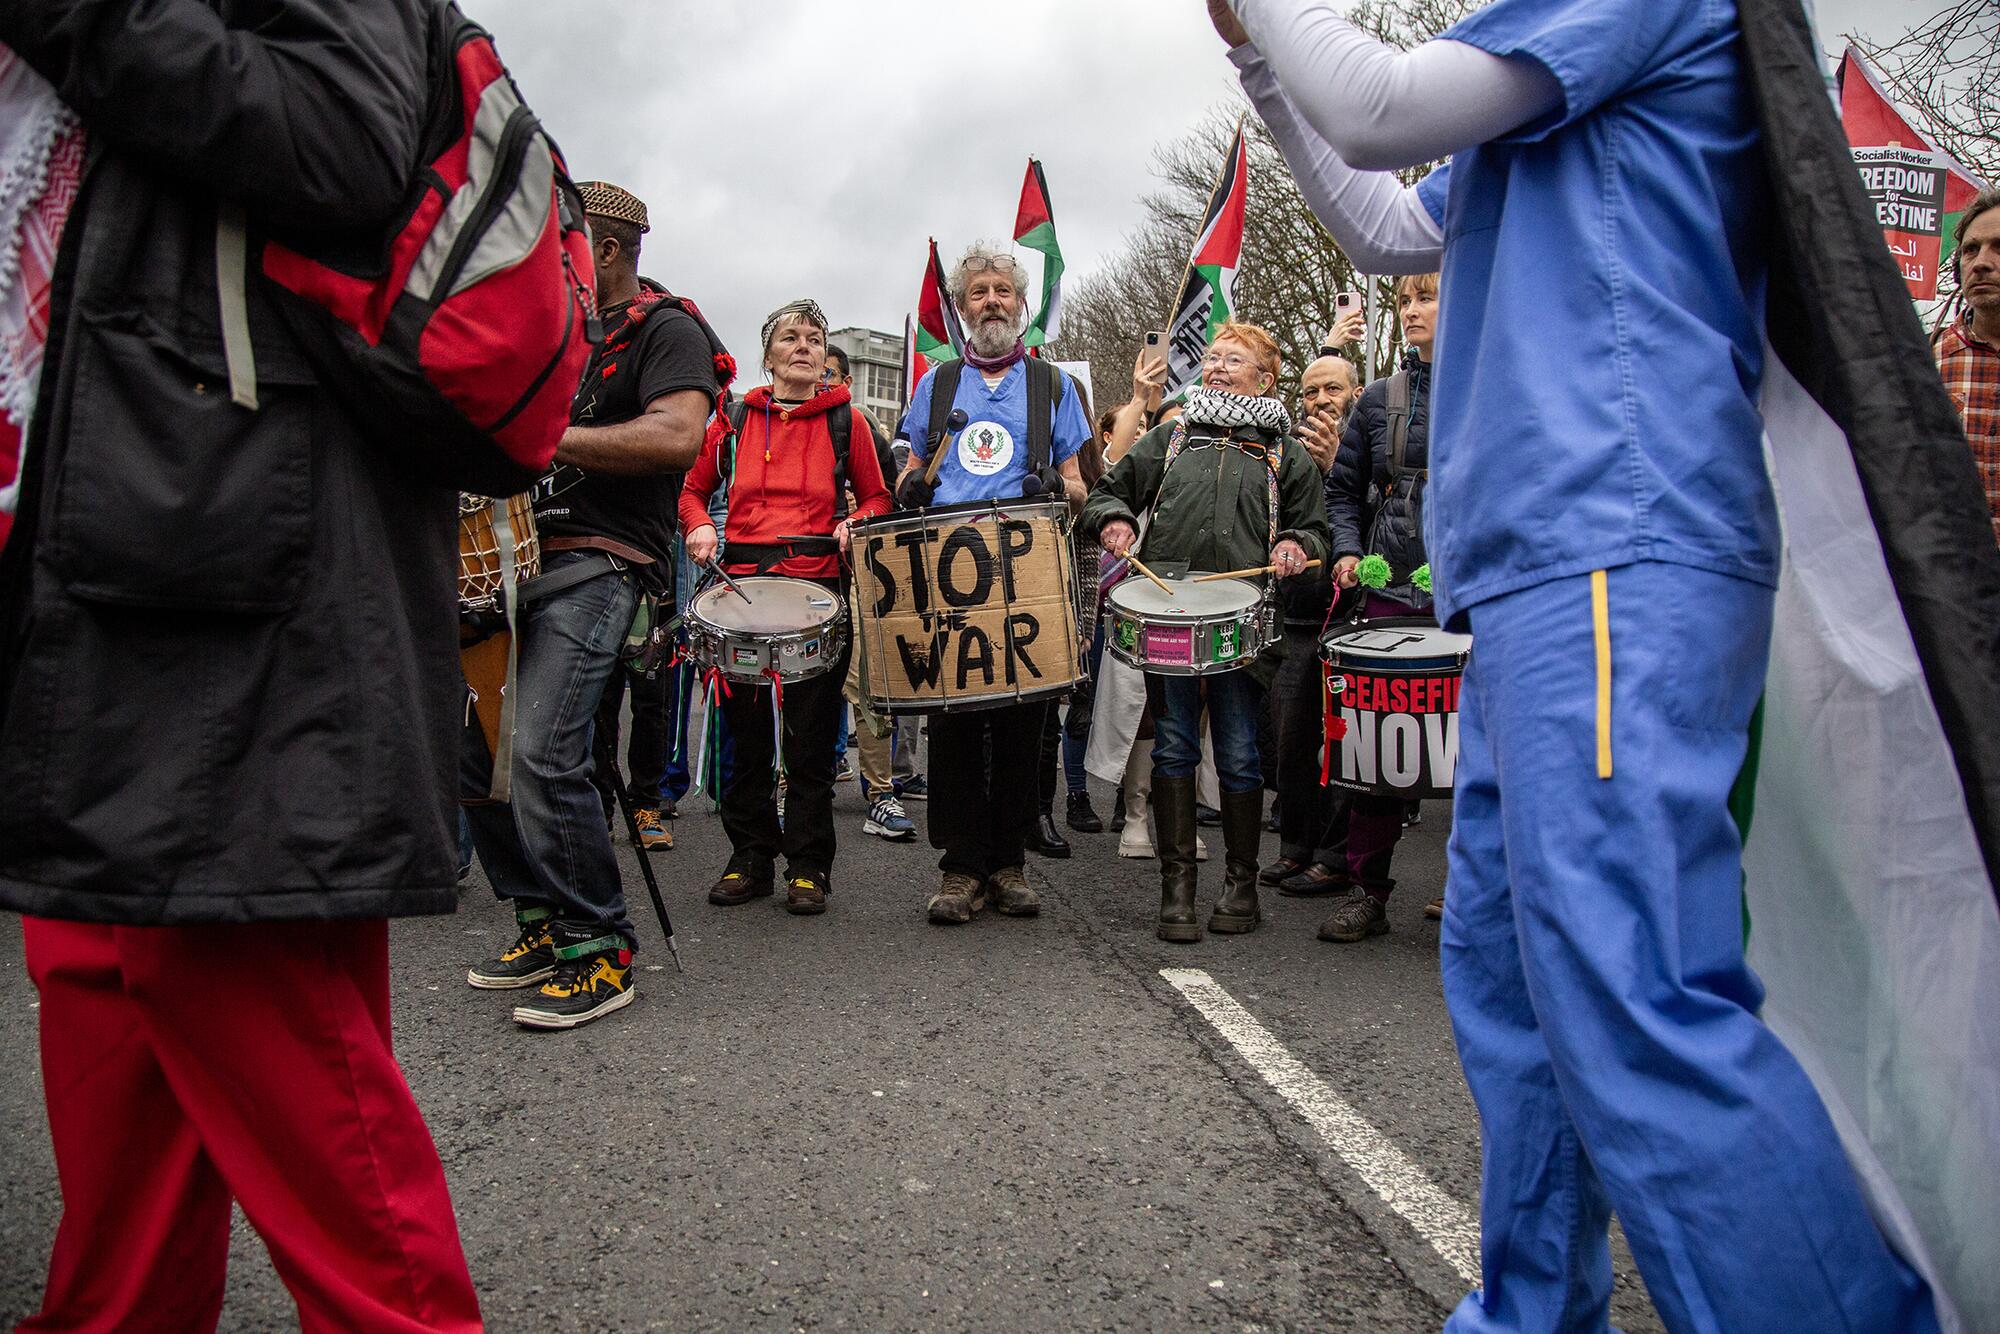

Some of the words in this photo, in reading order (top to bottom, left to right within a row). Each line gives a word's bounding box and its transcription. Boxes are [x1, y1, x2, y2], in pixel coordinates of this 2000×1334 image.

[1854, 150, 1900, 161] Socialist
[1900, 151, 1933, 166] Worker
[1859, 167, 1935, 195] REEDOM
[1885, 190, 1900, 201] for
[1876, 202, 1937, 231] ESTINE
[534, 508, 570, 519] TRUCTURED
[864, 519, 1033, 618] STOP
[919, 609, 970, 633] THE
[895, 612, 1043, 693] WAR
[1340, 673, 1462, 713] CEASEFI
